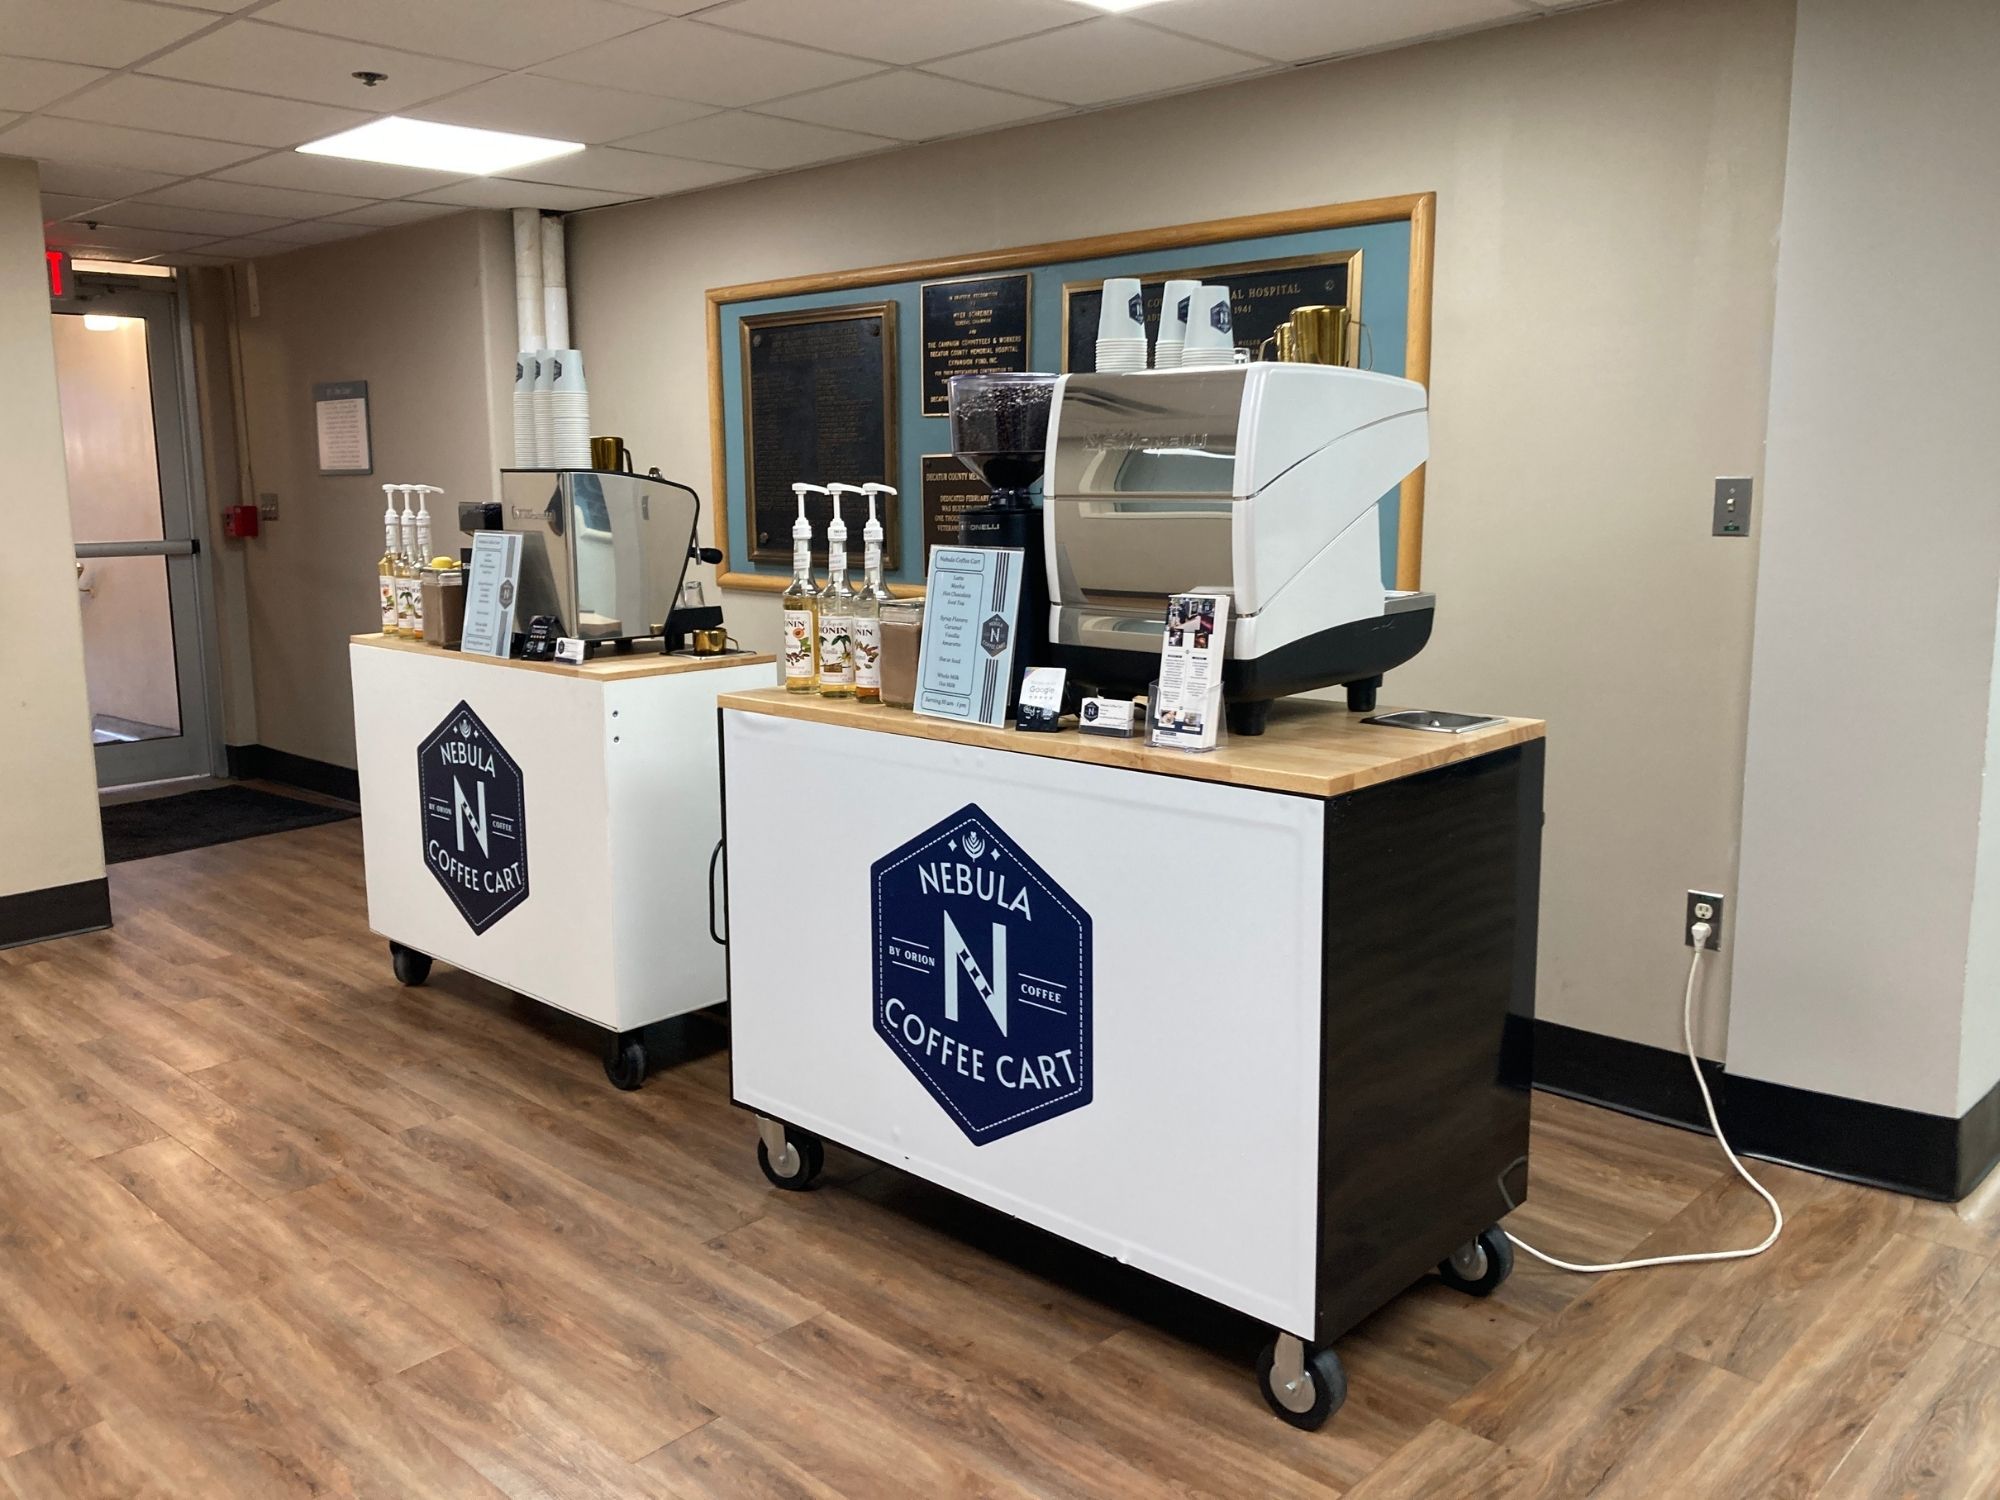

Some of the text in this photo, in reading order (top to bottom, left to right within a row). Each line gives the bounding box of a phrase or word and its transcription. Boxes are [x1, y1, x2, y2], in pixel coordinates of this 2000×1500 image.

[1248, 283, 1301, 298] HOSPITAL
[1233, 304, 1252, 314] 1941
[926, 473, 947, 481] DECATUR
[822, 626, 848, 634] ONIN
[989, 628, 1000, 642] N
[1030, 686, 1056, 695] Google
[440, 742, 496, 778] NEBULA
[453, 775, 489, 859] N
[492, 820, 512, 832] COFFEE
[429, 840, 522, 894] COFFEE CART
[918, 862, 1032, 922] NEBULA
[888, 945, 936, 967] BY ORION
[944, 909, 1008, 1038] N
[1020, 983, 1062, 1004] COFFEE
[885, 998, 1076, 1090] COFFEE CART
